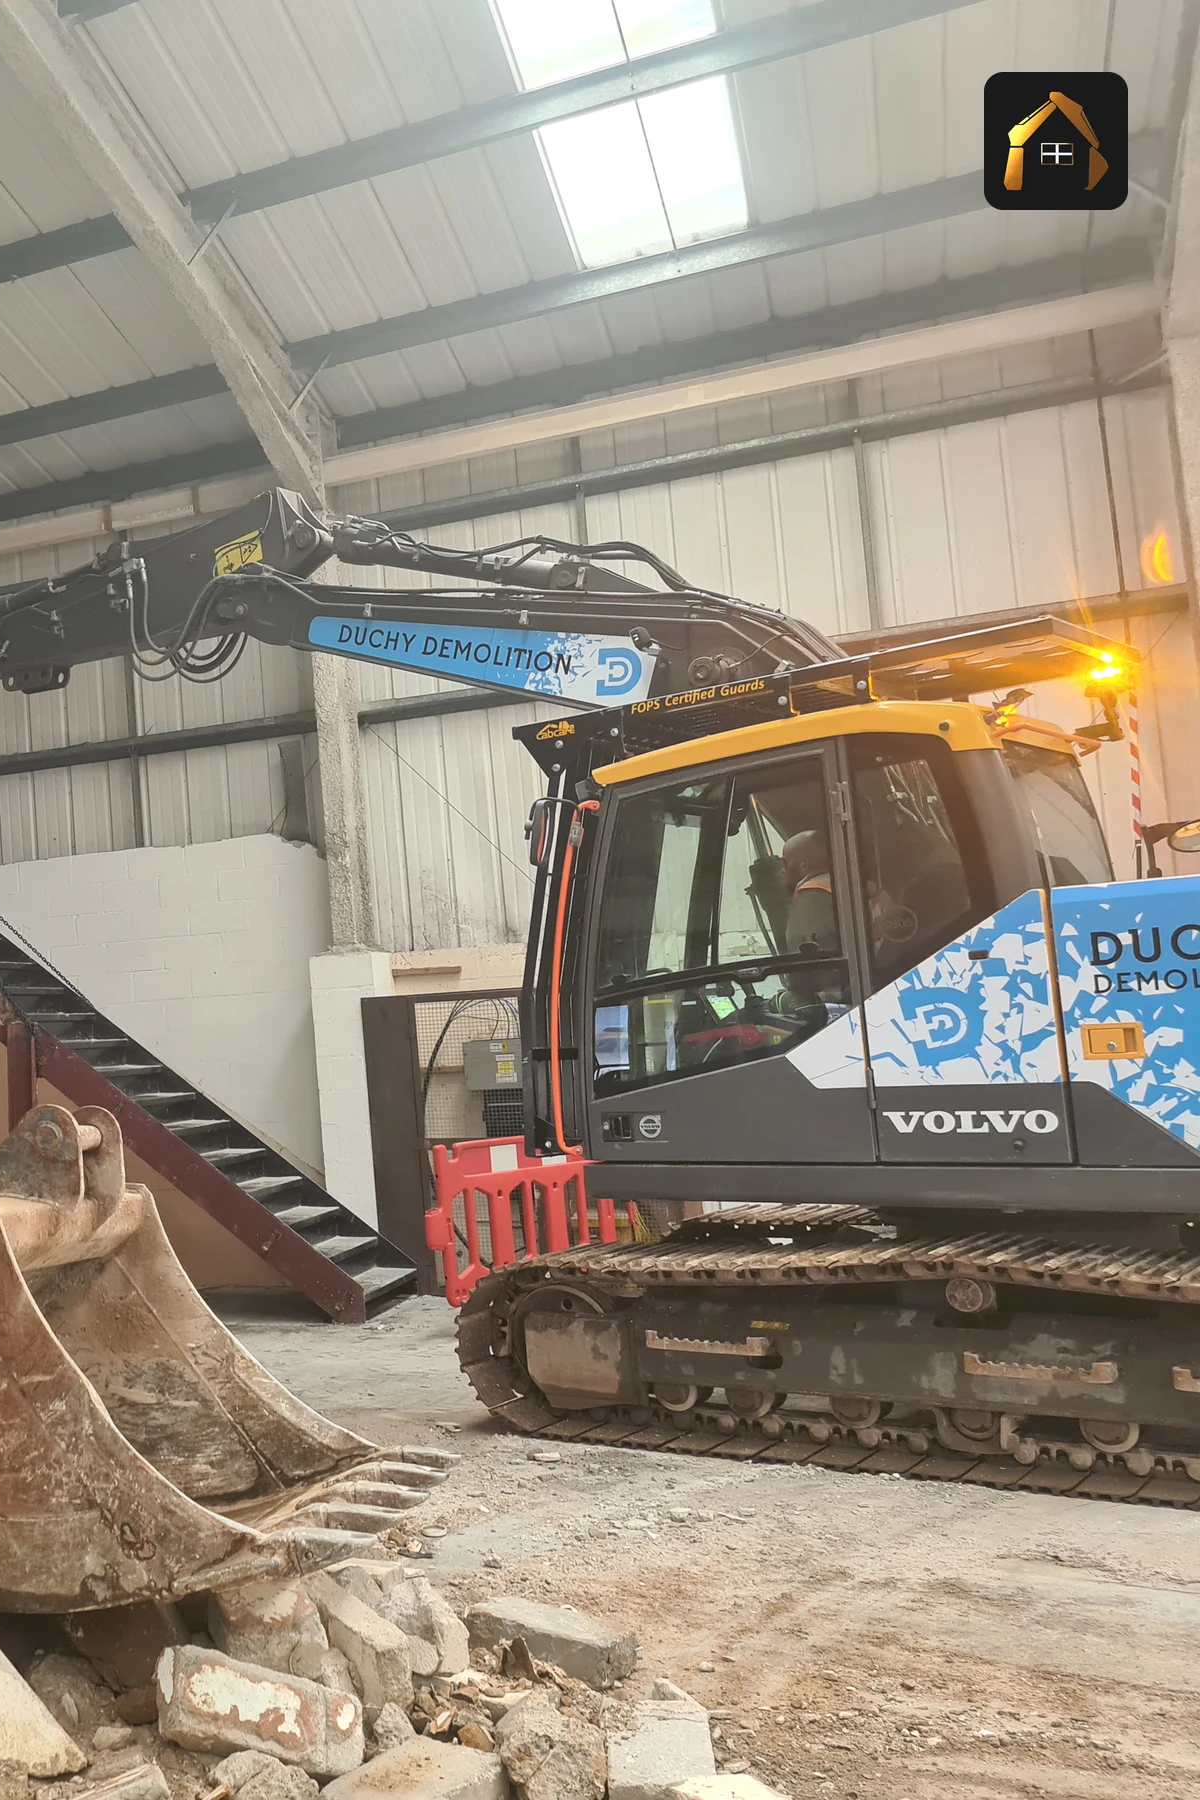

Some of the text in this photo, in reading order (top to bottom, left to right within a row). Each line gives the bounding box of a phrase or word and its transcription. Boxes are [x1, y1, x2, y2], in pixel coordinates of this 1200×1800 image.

[338, 624, 571, 675] DUCHY DEMOLITION
[631, 679, 766, 715] FOPS Certified Guards
[882, 1109, 1060, 1134] VOLVO
